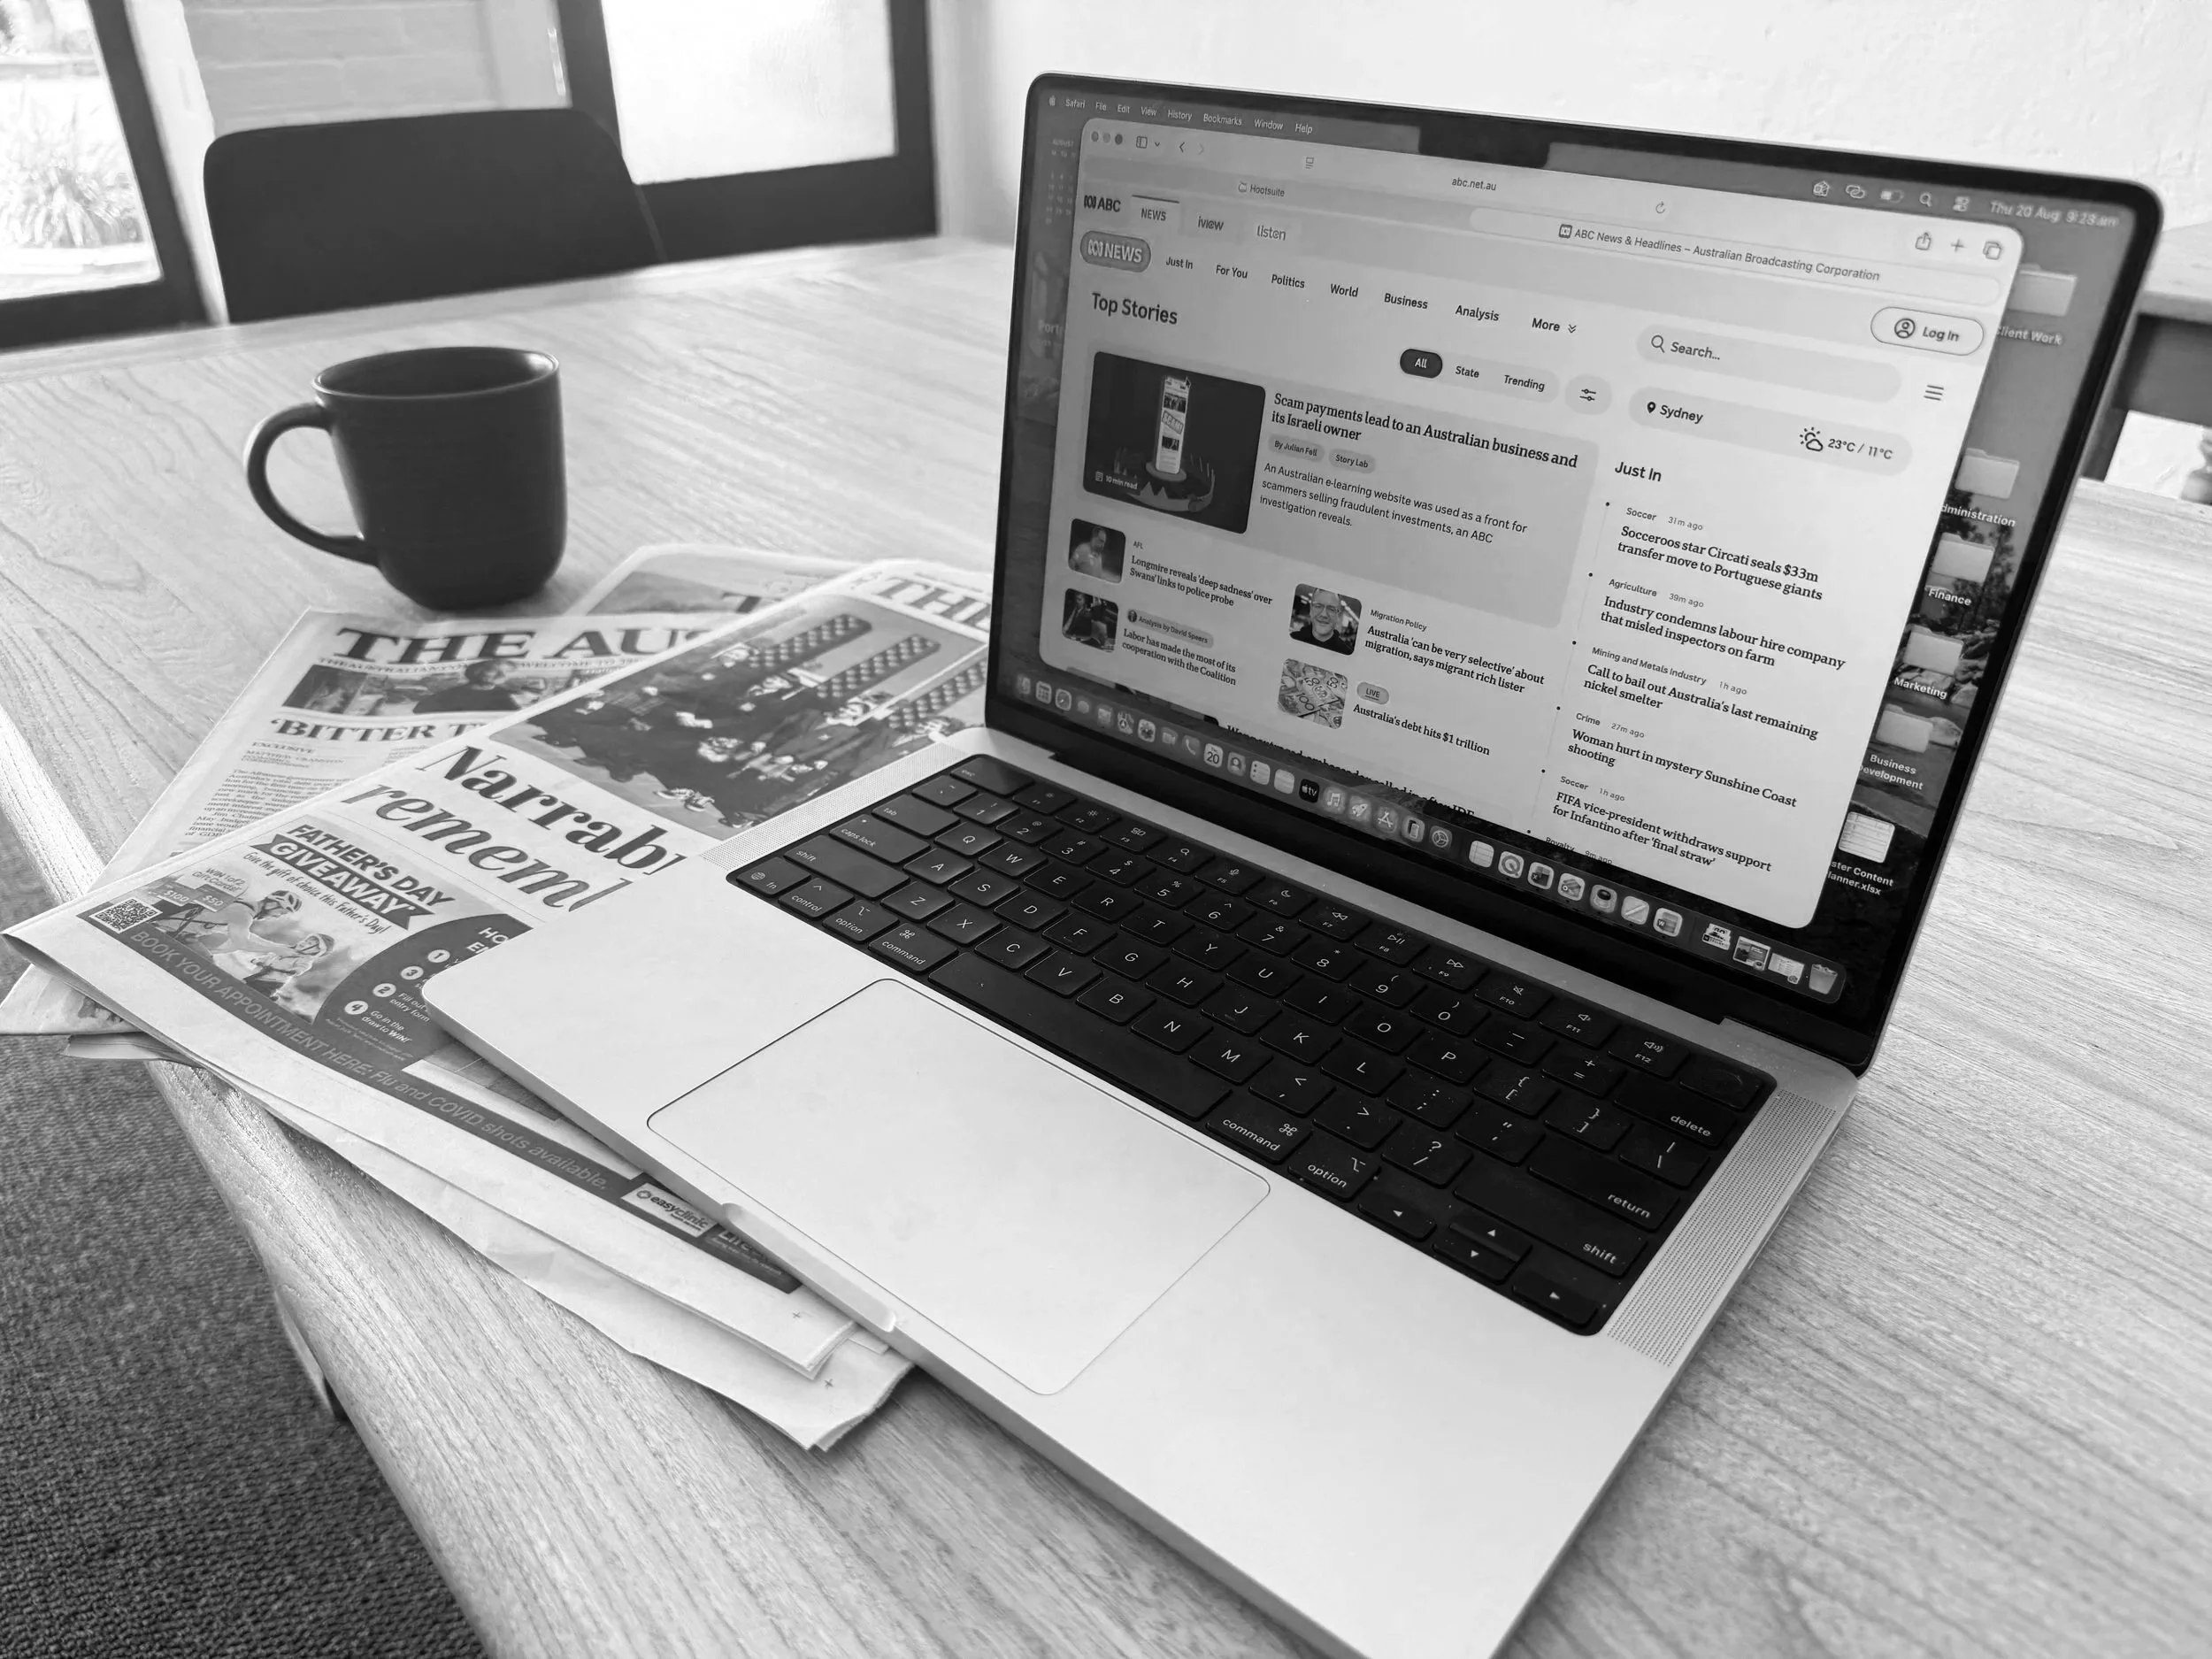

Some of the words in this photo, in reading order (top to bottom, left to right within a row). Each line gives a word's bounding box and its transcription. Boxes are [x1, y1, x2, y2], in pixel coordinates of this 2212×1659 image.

[1065, 98, 1086, 109] Safari
[1117, 104, 1130, 114] Edit
[1141, 106, 1157, 116] View
[1167, 109, 1193, 122] History
[1202, 113, 1242, 126] Bookmarks
[1254, 119, 1284, 130] Window
[1294, 123, 1313, 135] Help
[1249, 184, 1285, 197] Hootsuite
[1451, 177, 1497, 191] abc.net.au
[1097, 196, 1121, 212] ABC
[1141, 208, 1166, 221] NEWS
[1256, 225, 1286, 241] listen
[1104, 242, 1142, 263] NEWS
[1165, 257, 1184, 268] Just
[1185, 259, 1194, 270] In
[1216, 264, 1231, 276] For
[1232, 267, 1248, 279] You
[1271, 273, 1305, 288] Politics
[1330, 283, 1359, 297] World
[1092, 292, 1118, 317] Top
[1121, 298, 1178, 325] Stories
[1384, 293, 1428, 309] Business
[1455, 304, 1500, 321] Analysis
[1532, 318, 1561, 332] More
[1922, 326, 1947, 342] Log
[1947, 330, 1960, 342] In
[1670, 342, 1720, 360] Search...
[1414, 357, 1427, 369] All
[1455, 365, 1479, 379] State
[1504, 374, 1546, 393] Trending
[1659, 404, 1704, 425] Sydney
[1271, 410, 1286, 425] its
[1286, 413, 1323, 433] Israeli
[1323, 425, 1363, 441] owner
[1274, 393, 1304, 411] Scam
[1305, 403, 1363, 422] payments
[1364, 411, 1391, 428] lead
[1392, 419, 1404, 431] to
[1405, 424, 1421, 435] an
[1422, 425, 1490, 449] Australian
[1492, 437, 1550, 462] business
[1550, 454, 1578, 468] and
[1614, 461, 1647, 479] Just
[1648, 467, 1662, 482] In
[1625, 507, 1657, 521] Soccer
[1668, 516, 1686, 526] 31m
[1686, 522, 1703, 531] ago
[1621, 526, 1681, 549] Socceroos
[1681, 542, 1707, 555] star
[1707, 546, 1750, 565] Circati
[1749, 559, 1782, 573] seals
[1782, 564, 1818, 582] $33m
[1617, 542, 1665, 561] transfer
[1665, 555, 1698, 569] move
[1700, 561, 1712, 572] to
[1713, 564, 1783, 590] Portuguese
[1782, 583, 1823, 600] giants
[1929, 586, 1972, 606] Finance
[1370, 609, 1405, 625] Migration
[1404, 618, 1427, 633] Policy
[332, 627, 536, 664] THE
[543, 627, 713, 658] AU
[1367, 626, 1409, 645] Australia
[1431, 642, 1443, 655] be
[1444, 649, 1468, 664] very
[1514, 668, 1545, 685] about
[1364, 640, 1412, 661] migration,
[1412, 654, 1434, 667] says
[1435, 661, 1475, 679] migrant
[1475, 672, 1497, 686] rich
[1497, 676, 1525, 693] lister
[1893, 676, 1947, 700] Marketing
[1352, 703, 1401, 726] Australia's
[1401, 719, 1422, 733] debt
[1423, 725, 1441, 740] hits
[1441, 732, 1454, 744] $1
[1455, 737, 1490, 756] trillion
[1870, 754, 1916, 774] Business
[1553, 804, 1570, 818] for
[1570, 810, 1621, 835] Infantino
[1621, 830, 1650, 845] after
[1555, 791, 1582, 809] FIFA
[1584, 803, 1662, 834] vice-president
[1663, 829, 1724, 856] withdraws
[1724, 850, 1772, 872] support
[841, 829, 860, 839] caps
[859, 837, 875, 847] lock
[243, 852, 259, 864] Give
[796, 851, 816, 861] shift
[261, 861, 273, 873] the
[266, 865, 288, 881] gift
[288, 824, 401, 880] FATHER'S
[391, 875, 456, 907] DAY
[288, 875, 301, 887] of
[296, 878, 321, 898] choice
[164, 890, 189, 902] $100
[203, 895, 224, 906] $50
[321, 892, 336, 906] this
[792, 896, 822, 911] control
[336, 902, 369, 924] Father's
[366, 918, 391, 934] Day!
[836, 918, 863, 933] option
[880, 941, 926, 967] command
[1177, 978, 1193, 987] H
[389, 998, 411, 1012] entry
[398, 993, 413, 1002] Fill
[1109, 994, 1123, 1003] B
[361, 1017, 381, 1027] draw
[371, 1010, 383, 1019] Go
[390, 1020, 404, 1031] the
[1294, 1033, 1309, 1043] K
[131, 930, 181, 962] BOOK
[177, 956, 217, 989] YOUR
[214, 983, 330, 1051] APPOINTMENT
[321, 1046, 373, 1074] HERE:
[373, 1069, 397, 1087] Flu
[395, 1079, 429, 1101] and
[427, 1095, 484, 1126] COVID
[481, 1120, 530, 1149] shots
[529, 1145, 607, 1190] available.
[1222, 1049, 1240, 1062] M
[1671, 1117, 1710, 1136] delete
[1221, 1120, 1282, 1153] command
[1308, 1165, 1347, 1187] option
[650, 1195, 709, 1228] easyclinic
[1608, 1194, 1649, 1217] return
[1584, 1244, 1616, 1263] shift
